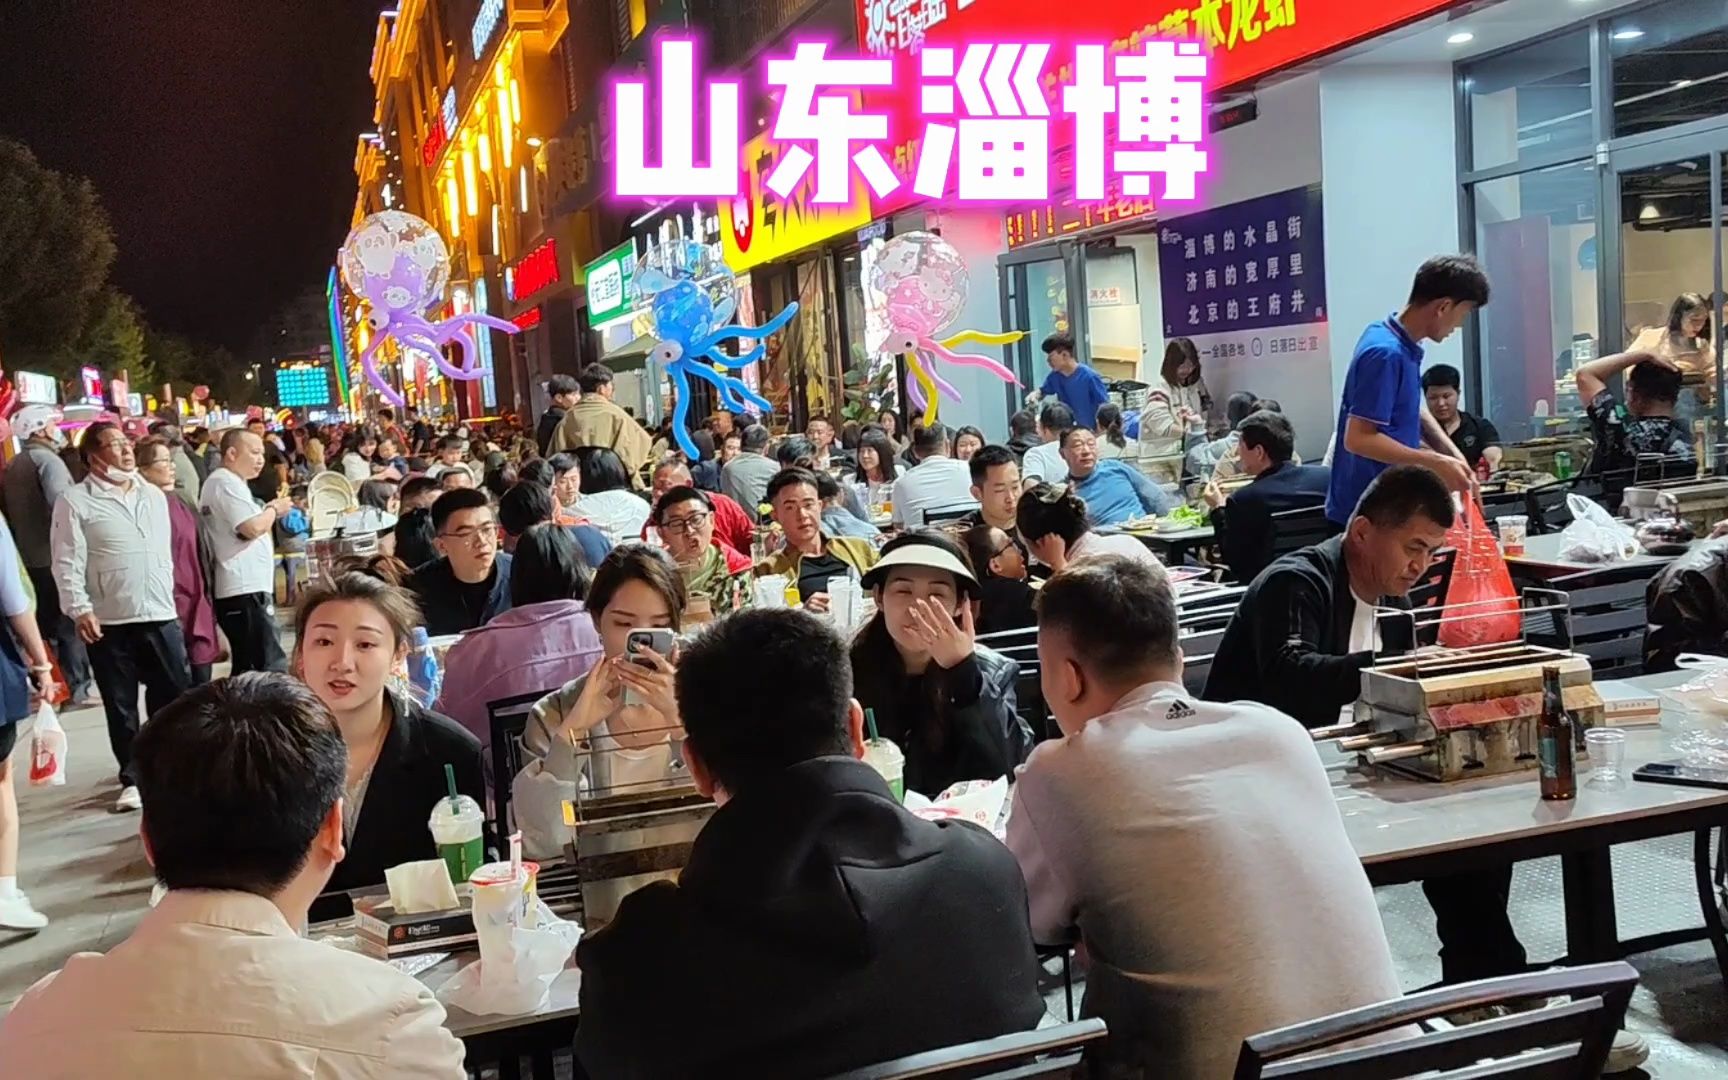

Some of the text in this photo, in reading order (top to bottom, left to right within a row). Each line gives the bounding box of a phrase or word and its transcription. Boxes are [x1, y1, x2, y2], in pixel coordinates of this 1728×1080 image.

[1184, 216, 1302, 259] 淄博的水晶街
[1186, 253, 1304, 292] 济南的宽厚里
[1188, 290, 1305, 325] 北京的王府井
[1166, 710, 1196, 720] adidas
